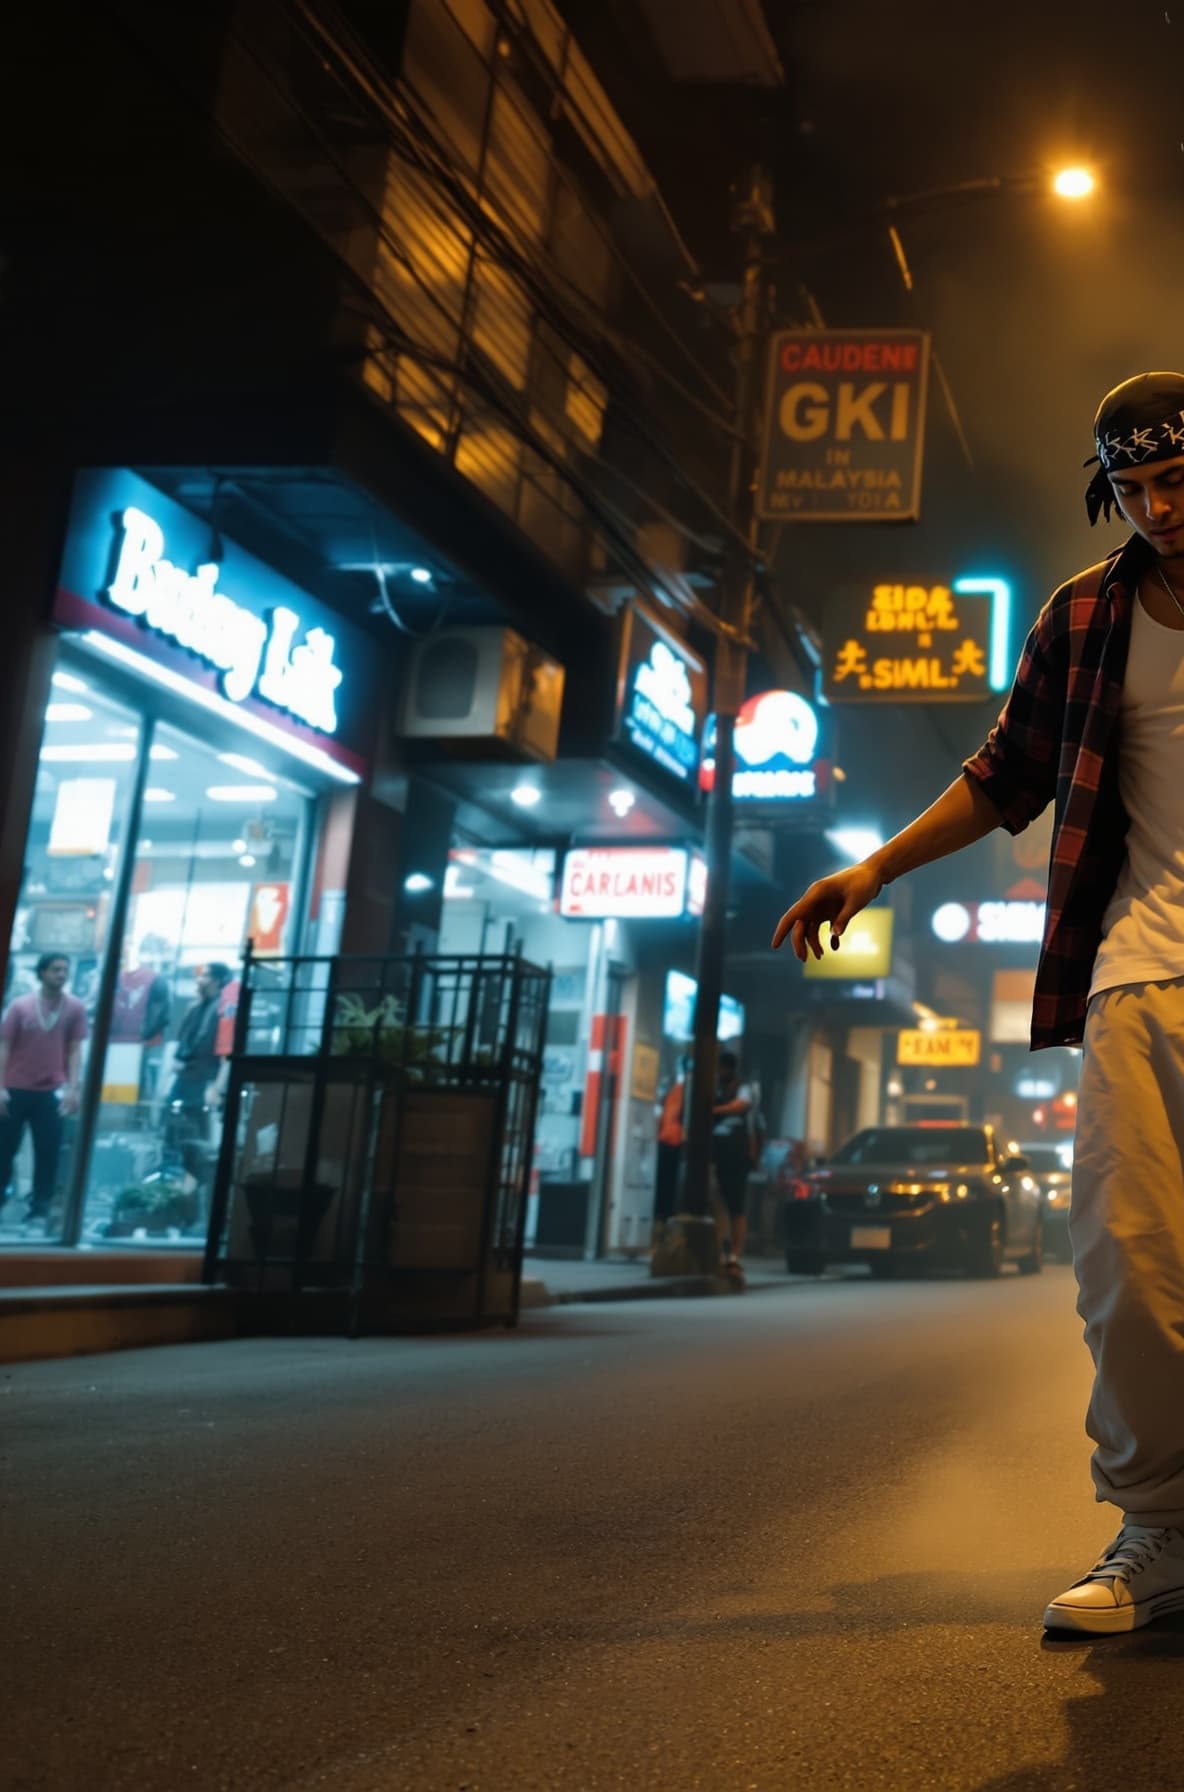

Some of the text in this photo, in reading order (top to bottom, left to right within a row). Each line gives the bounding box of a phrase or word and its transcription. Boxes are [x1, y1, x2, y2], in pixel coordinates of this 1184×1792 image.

[779, 381, 911, 441] GKI
[777, 469, 902, 489] MALAYSIA
[570, 872, 676, 897] CARLANIS
